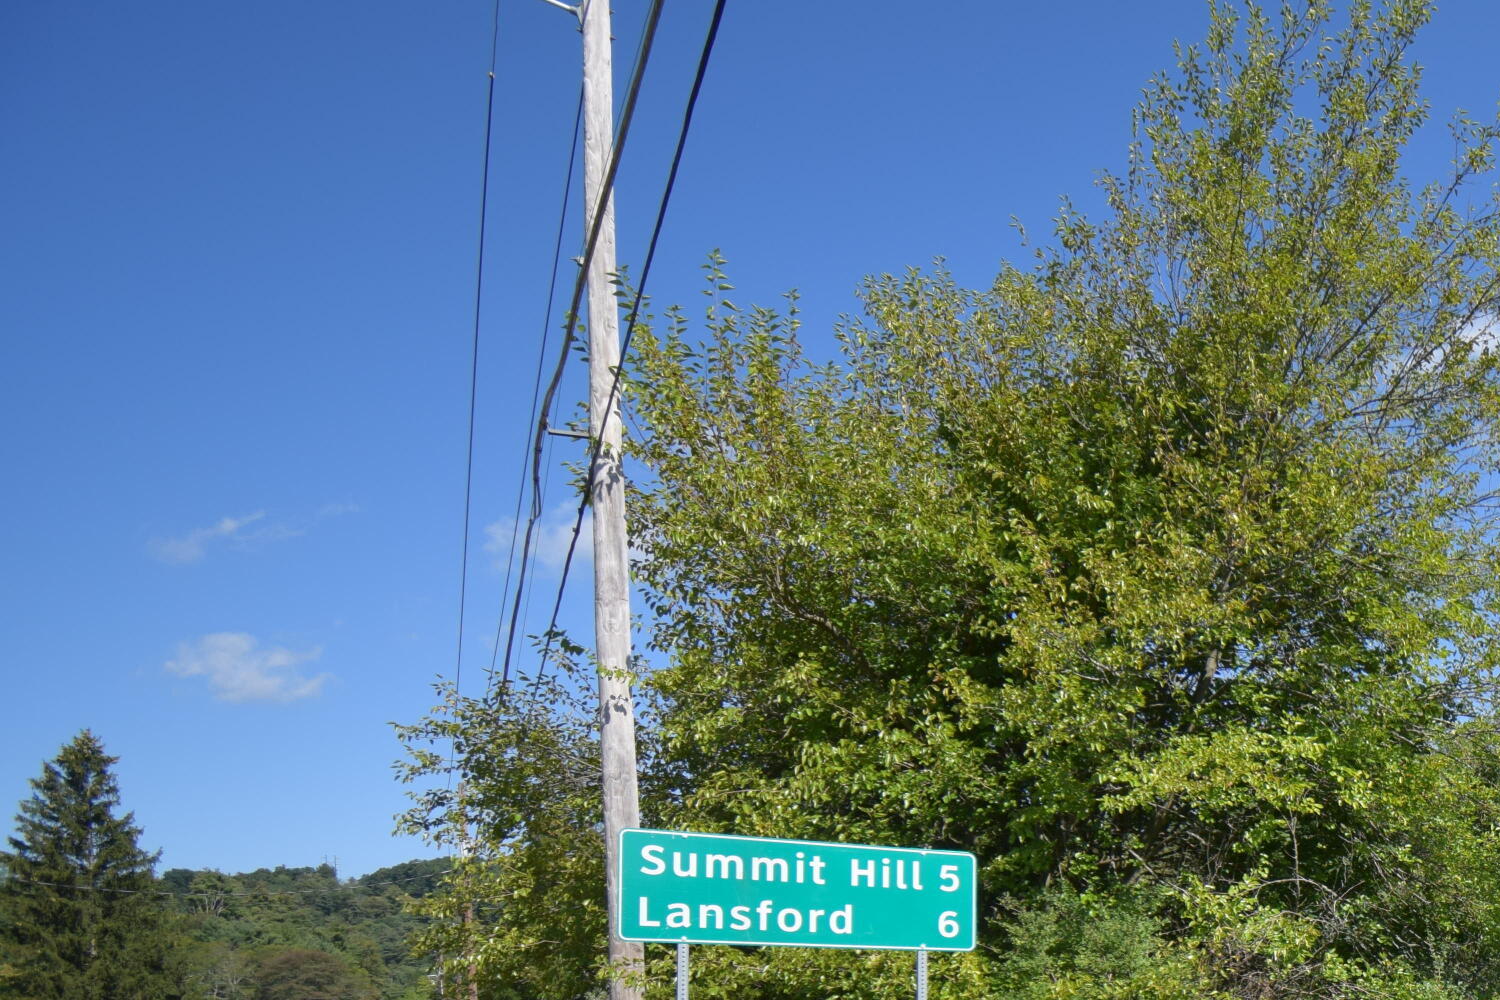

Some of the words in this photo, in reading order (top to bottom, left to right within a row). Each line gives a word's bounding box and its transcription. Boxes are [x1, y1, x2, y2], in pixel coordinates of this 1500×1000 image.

[640, 844, 826, 885] Summit
[851, 858, 923, 890] Hill
[939, 864, 960, 892] 5
[638, 896, 852, 934] Lansford
[938, 911, 959, 938] 6
